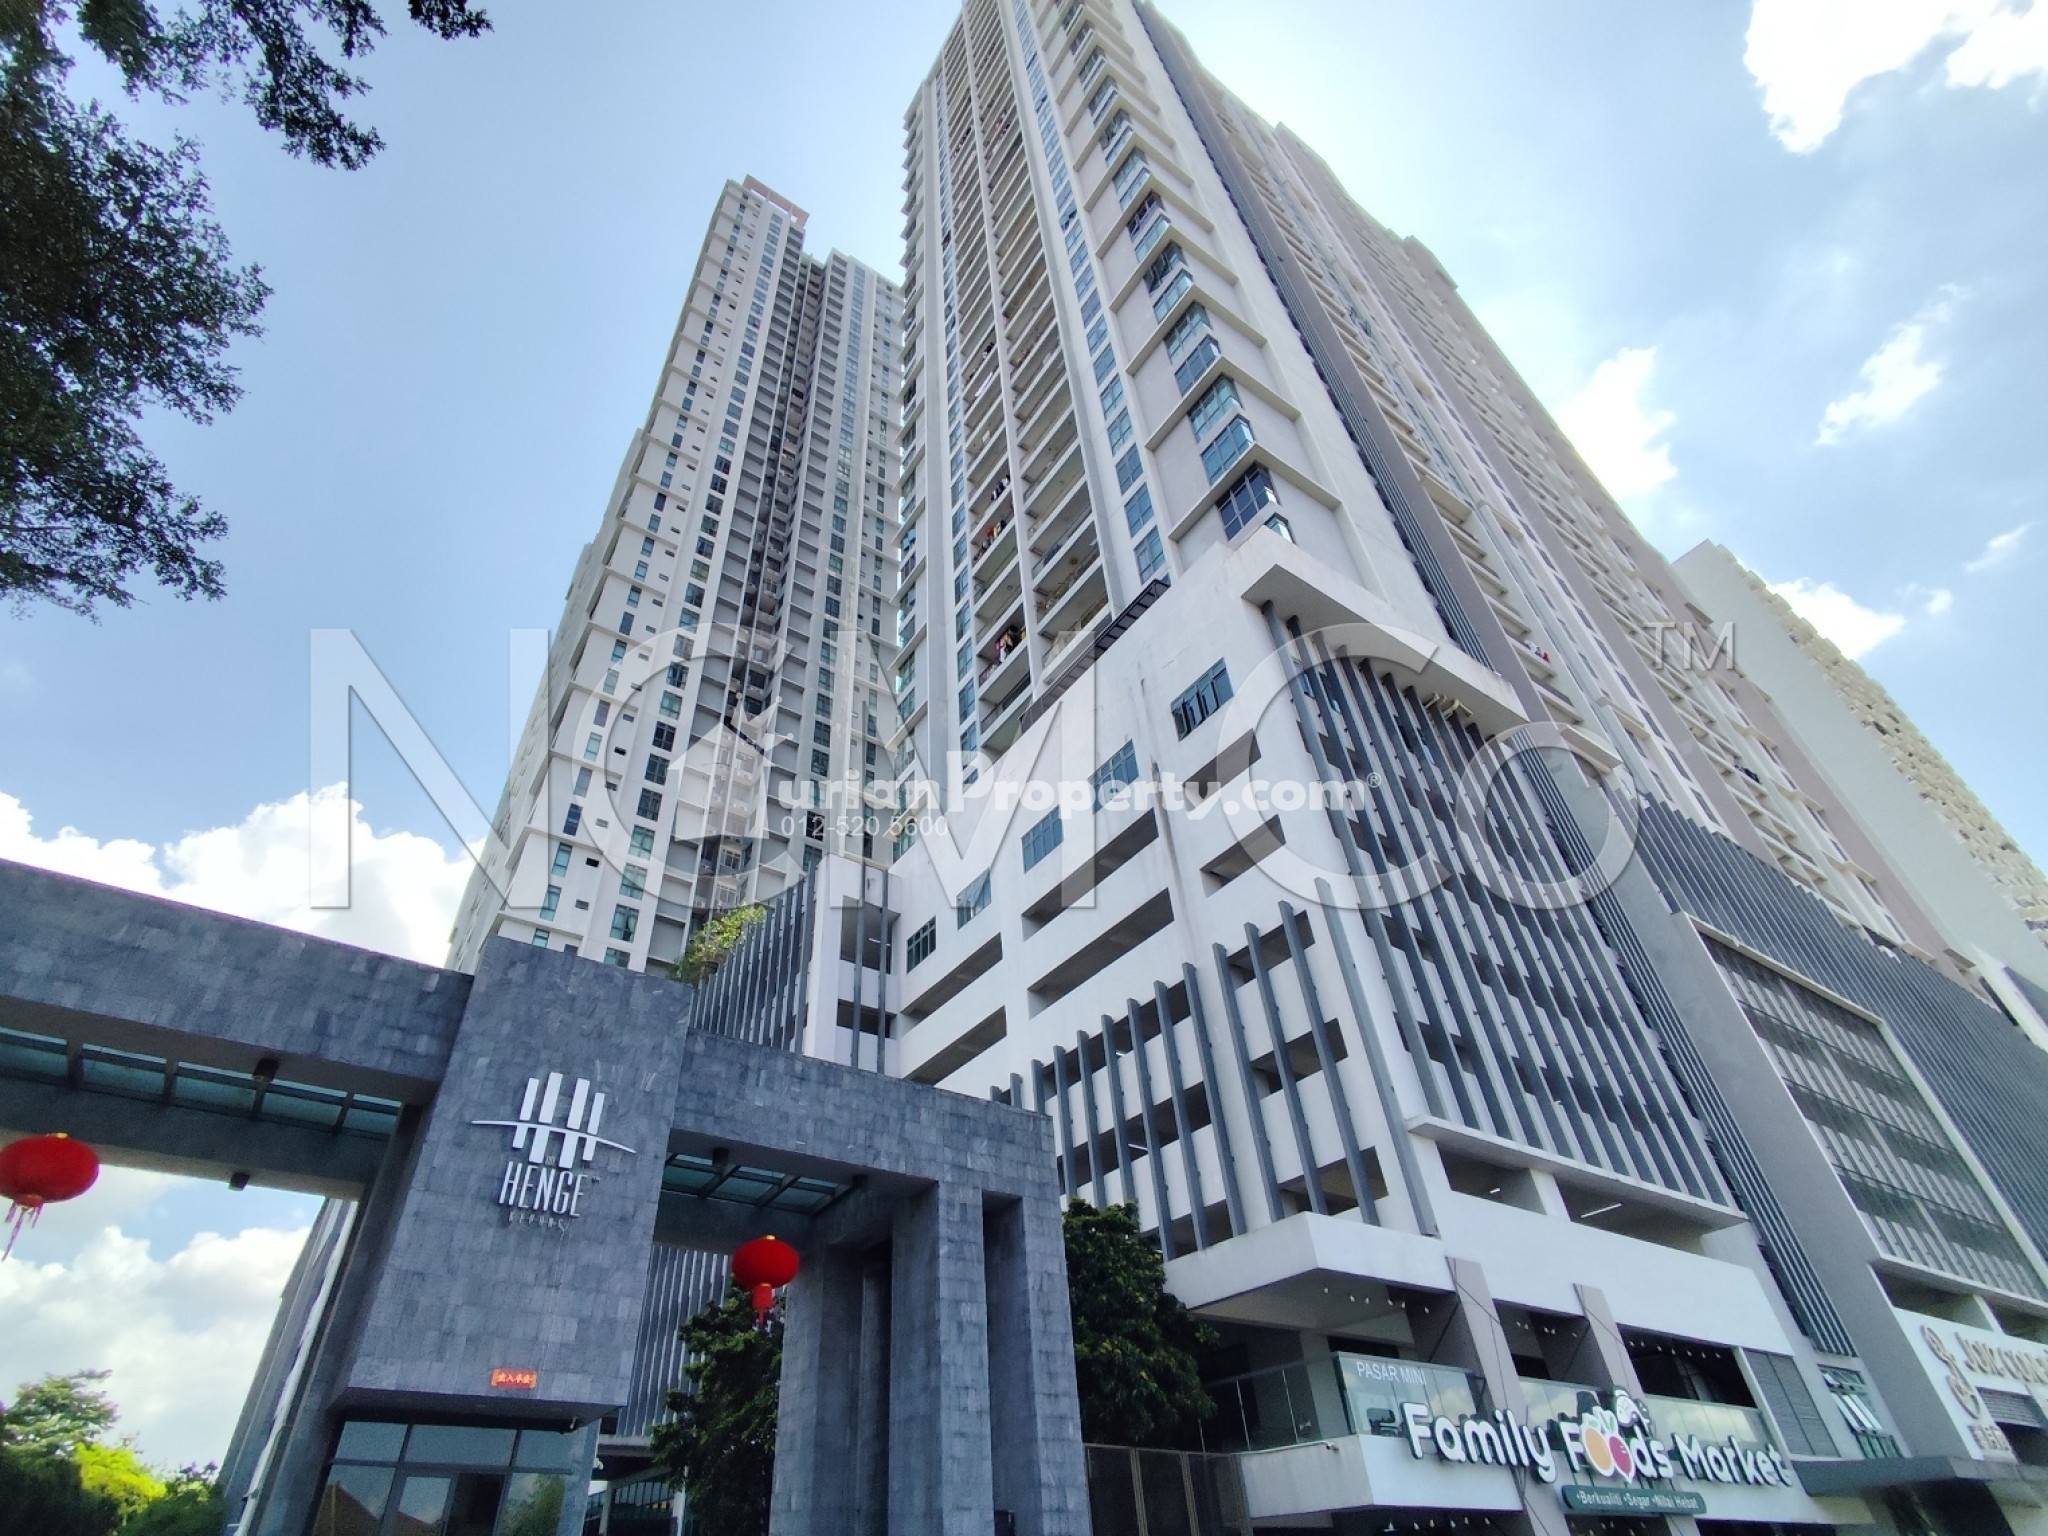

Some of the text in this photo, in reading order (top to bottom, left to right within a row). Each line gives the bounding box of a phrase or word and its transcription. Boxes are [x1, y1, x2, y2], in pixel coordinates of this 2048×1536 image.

[499, 1161, 588, 1218] HENGE
[1356, 1361, 1427, 1385] PASAR MINI
[1401, 1402, 1556, 1483] Family
[1672, 1432, 1793, 1487] Market
